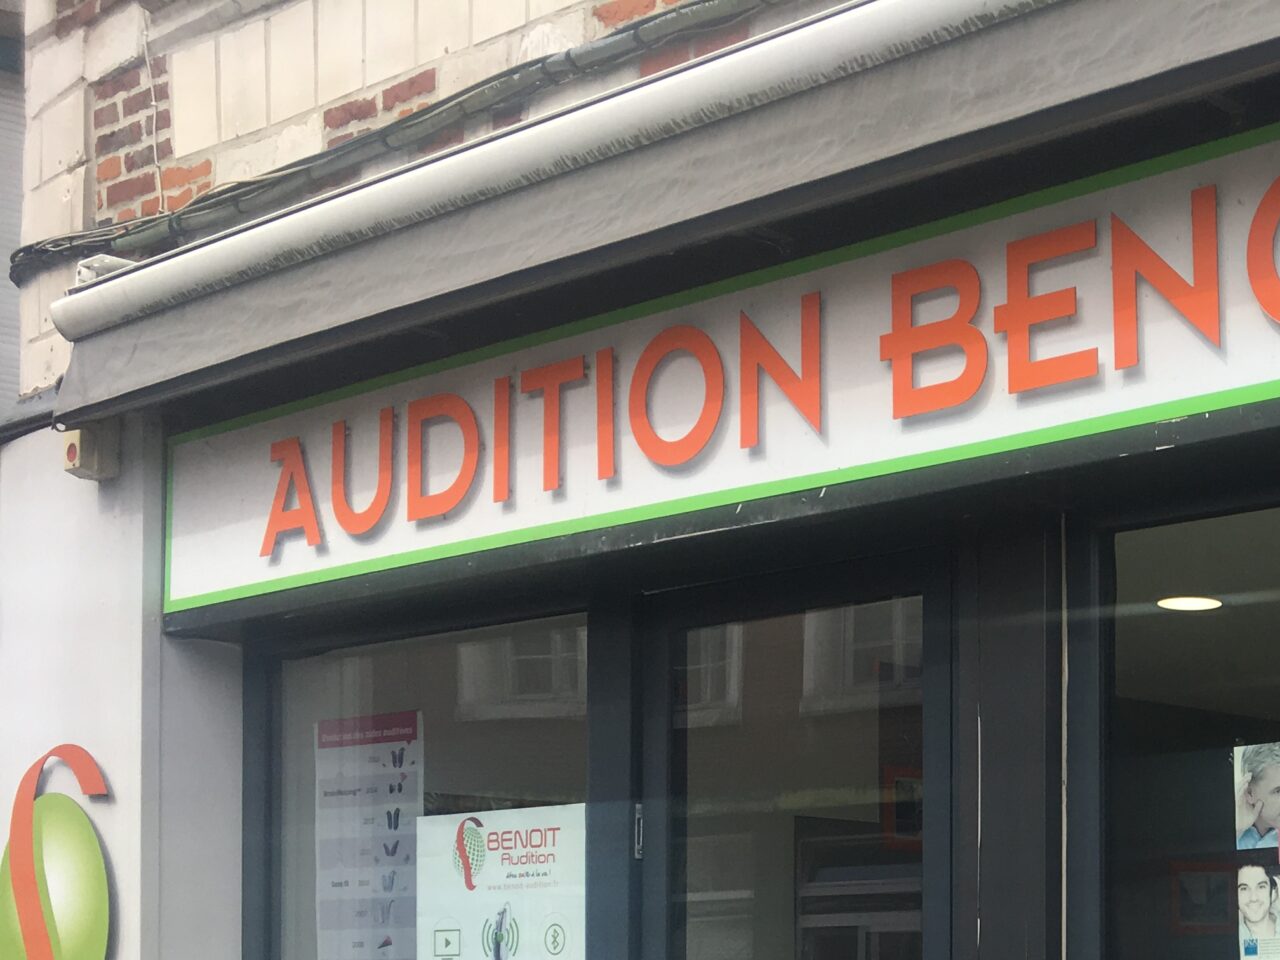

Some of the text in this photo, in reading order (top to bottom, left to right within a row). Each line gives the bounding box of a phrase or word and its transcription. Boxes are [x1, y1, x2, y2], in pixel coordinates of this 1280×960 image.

[260, 291, 822, 557] AUDITION
[487, 827, 560, 851] BENOIT
[501, 851, 556, 866] Audition
